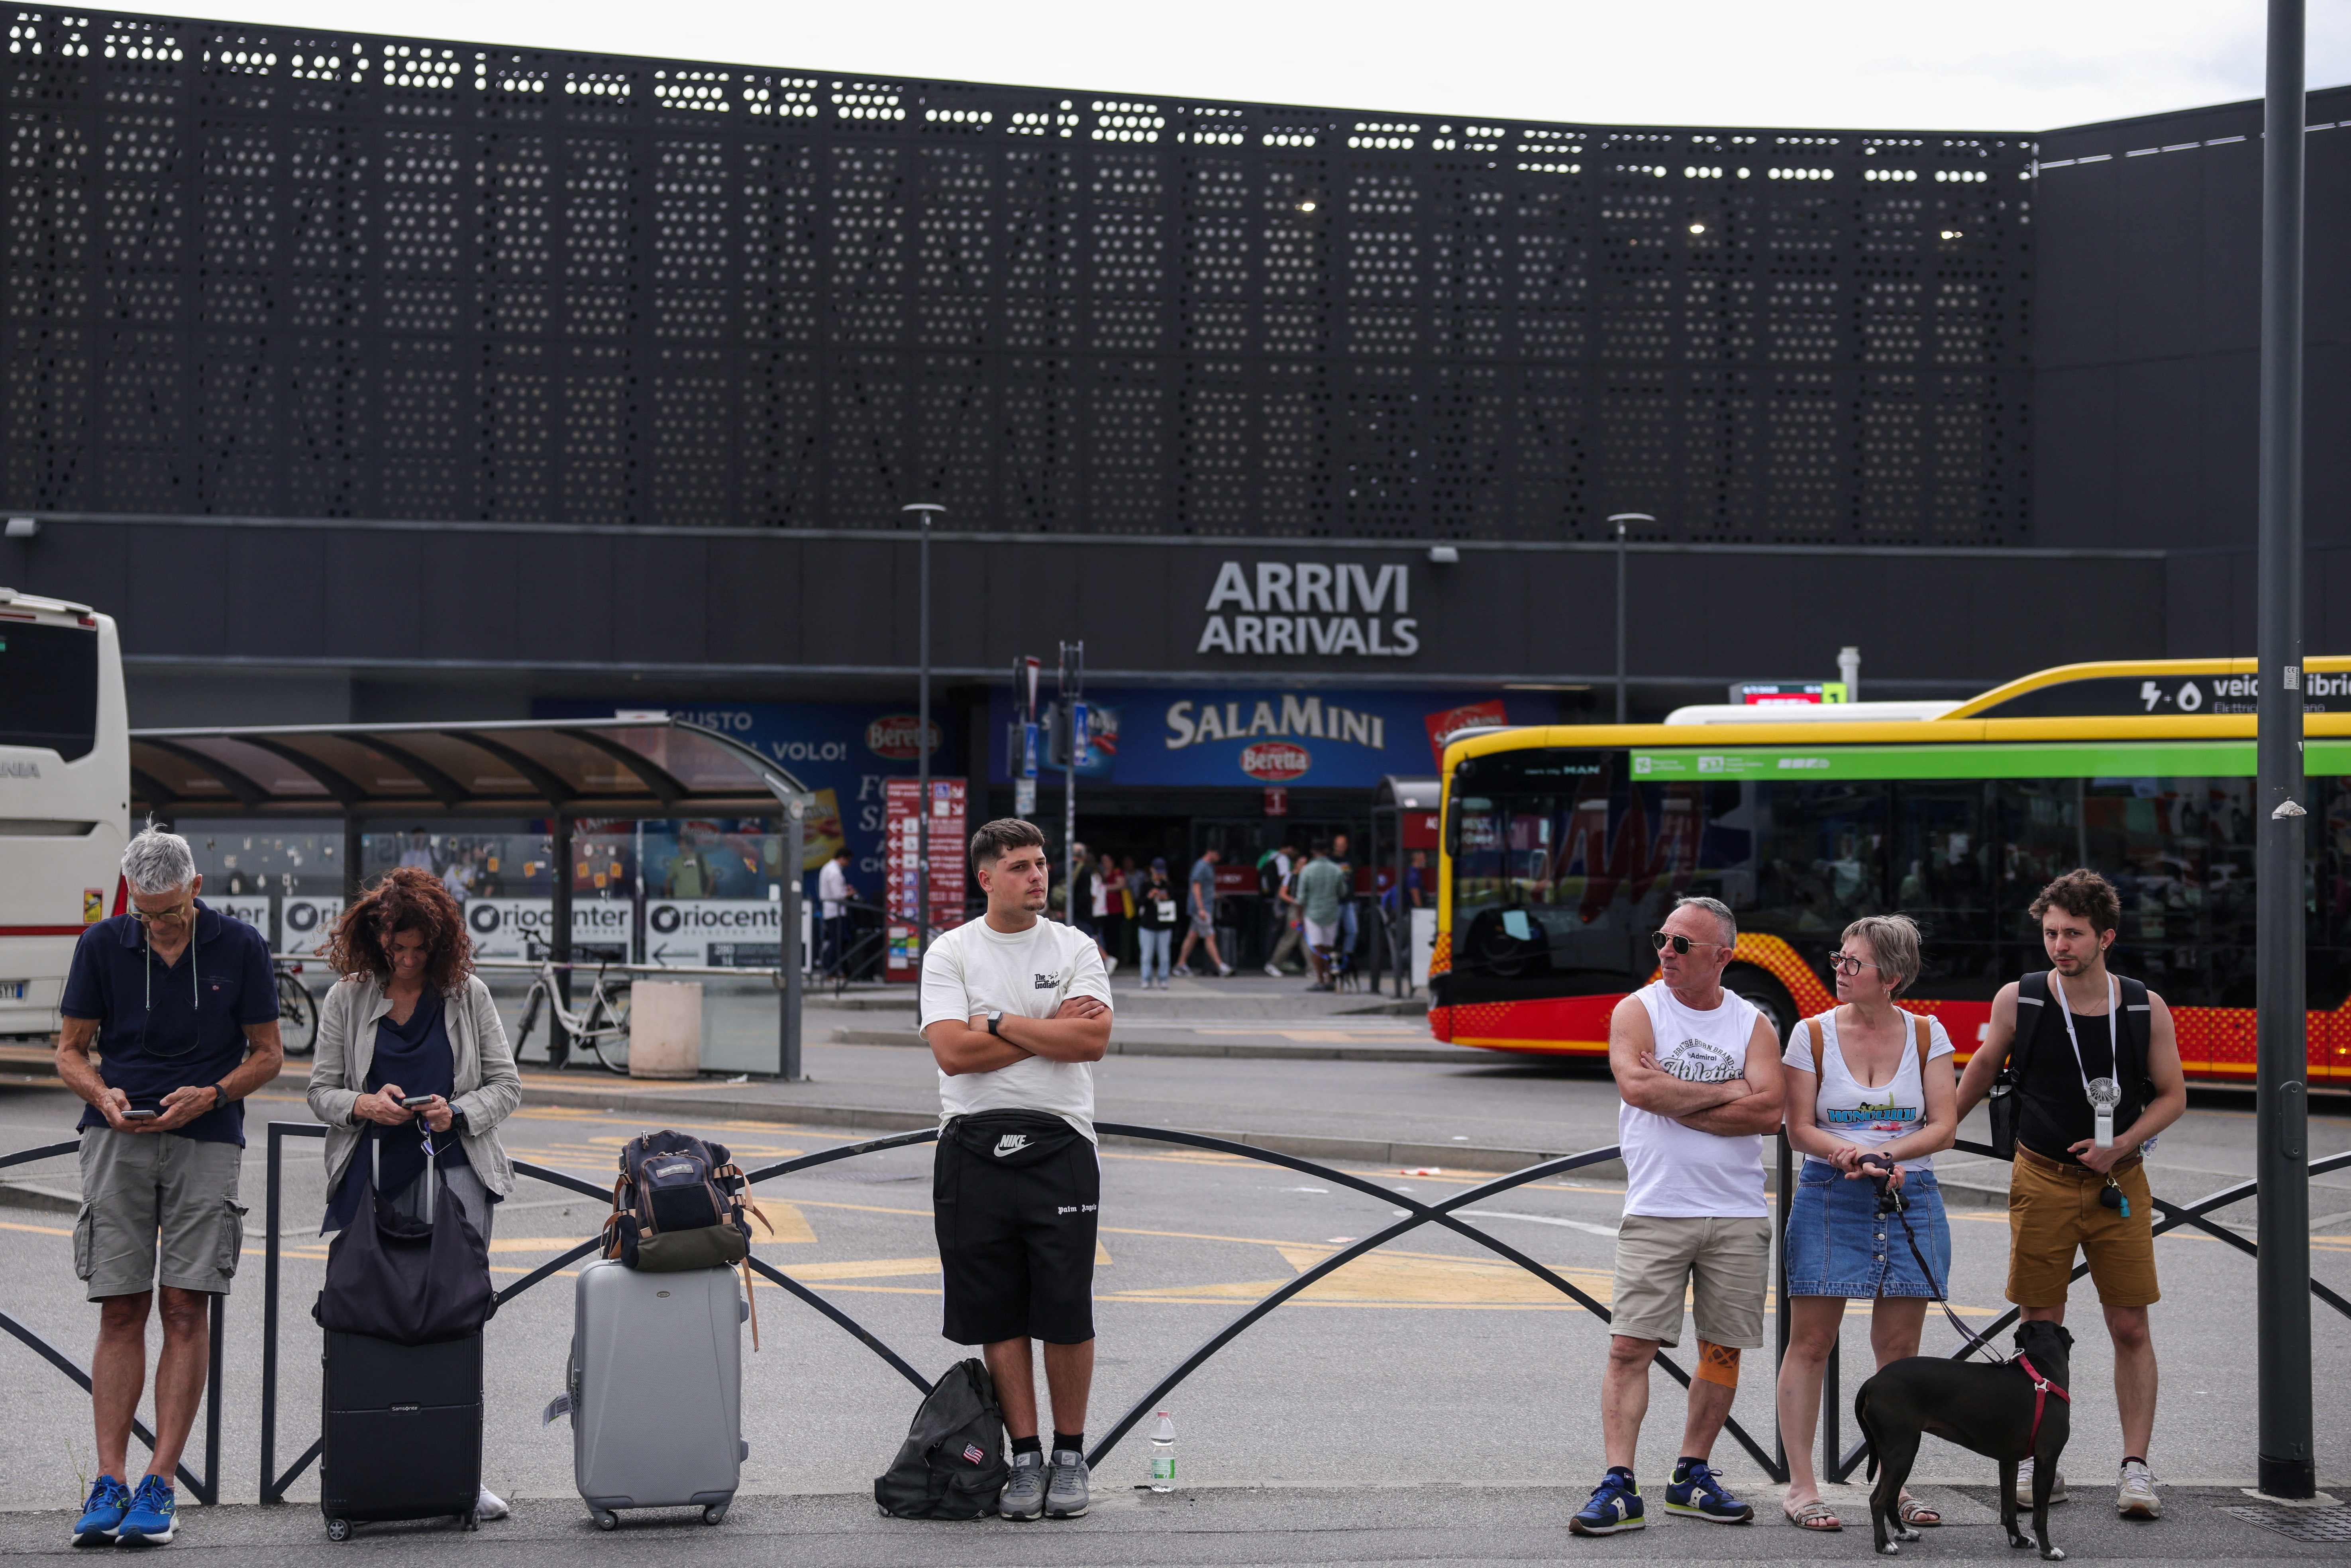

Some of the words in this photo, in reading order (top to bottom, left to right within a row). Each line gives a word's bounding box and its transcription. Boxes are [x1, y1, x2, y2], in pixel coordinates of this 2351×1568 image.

[1205, 561, 1408, 613] ARRIVI
[1197, 616, 1419, 655] ARRIVALS
[2305, 673, 2351, 697] ibri
[2214, 701, 2258, 714] Elettric
[1165, 694, 1384, 750] SALAMINI
[771, 742, 847, 761] VOLO!
[1242, 748, 1308, 772] Beretta
[0, 761, 41, 779] NIA
[1563, 765, 1600, 775] MAN
[470, 904, 628, 934] Oriocnter
[651, 905, 781, 934] Oriocent
[1035, 980, 1060, 989] Godfather
[1690, 1052, 1717, 1061] Admiral
[1695, 1038, 1712, 1051] BORN
[1713, 1047, 1735, 1066] BRAND
[1827, 1107, 1917, 1123] HONOLULU
[999, 1135, 1026, 1147] NIKE
[1058, 1206, 1077, 1215] Palm
[1081, 1203, 1097, 1212] Angels
